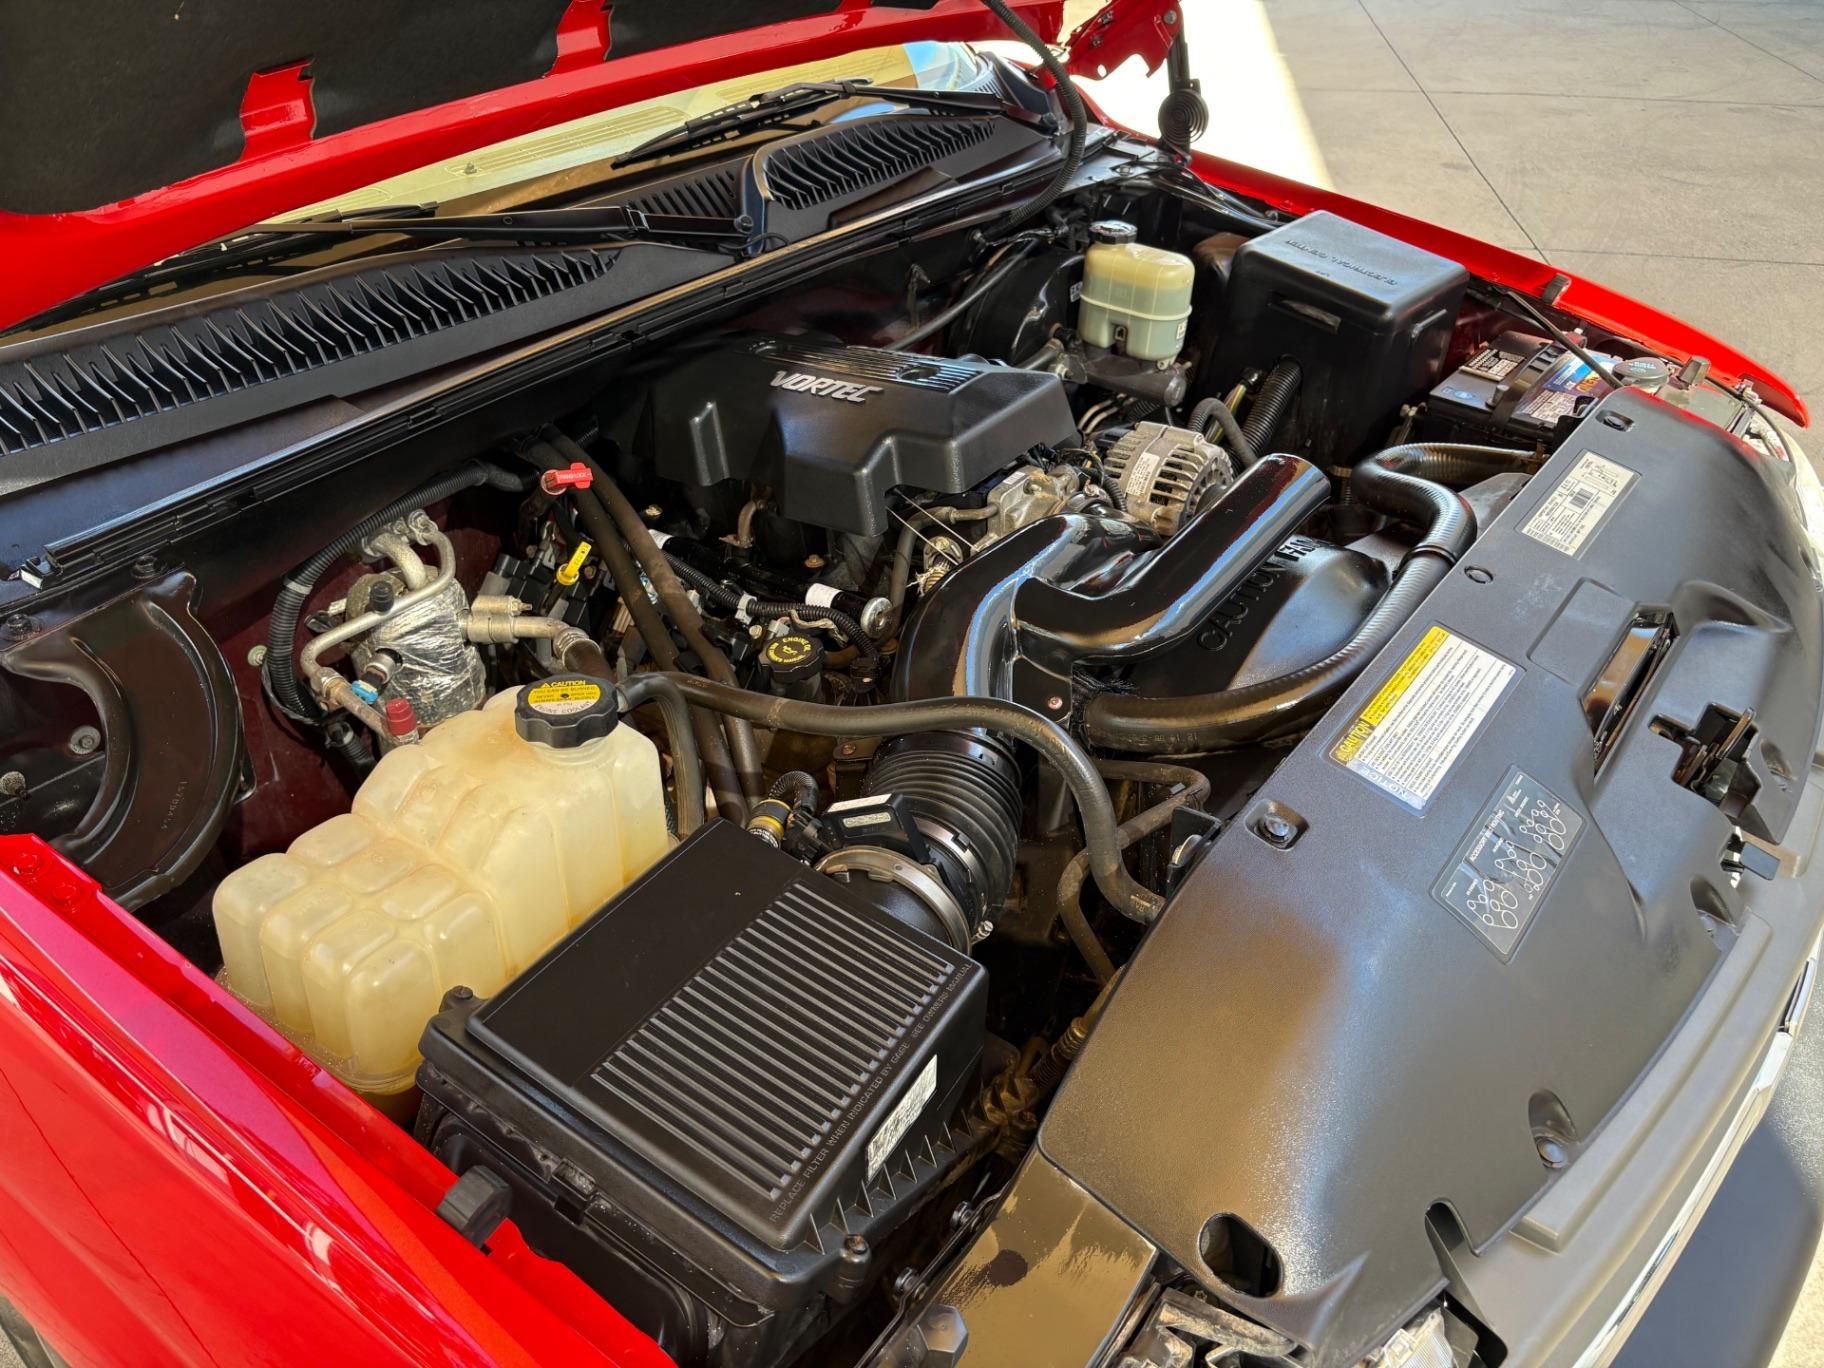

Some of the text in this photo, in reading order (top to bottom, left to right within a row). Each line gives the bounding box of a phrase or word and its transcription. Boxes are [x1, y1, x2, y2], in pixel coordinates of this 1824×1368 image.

[770, 370, 884, 402] VORTEC
[551, 680, 586, 688] CAUTION
[1339, 721, 1370, 753] CAUTION
[1359, 766, 1408, 798] NOTICE
[769, 1179, 805, 1223] REPLACE
[802, 1148, 829, 1180] FILTER
[826, 1118, 850, 1147] WHEN
[849, 1074, 884, 1120] INDICATED
